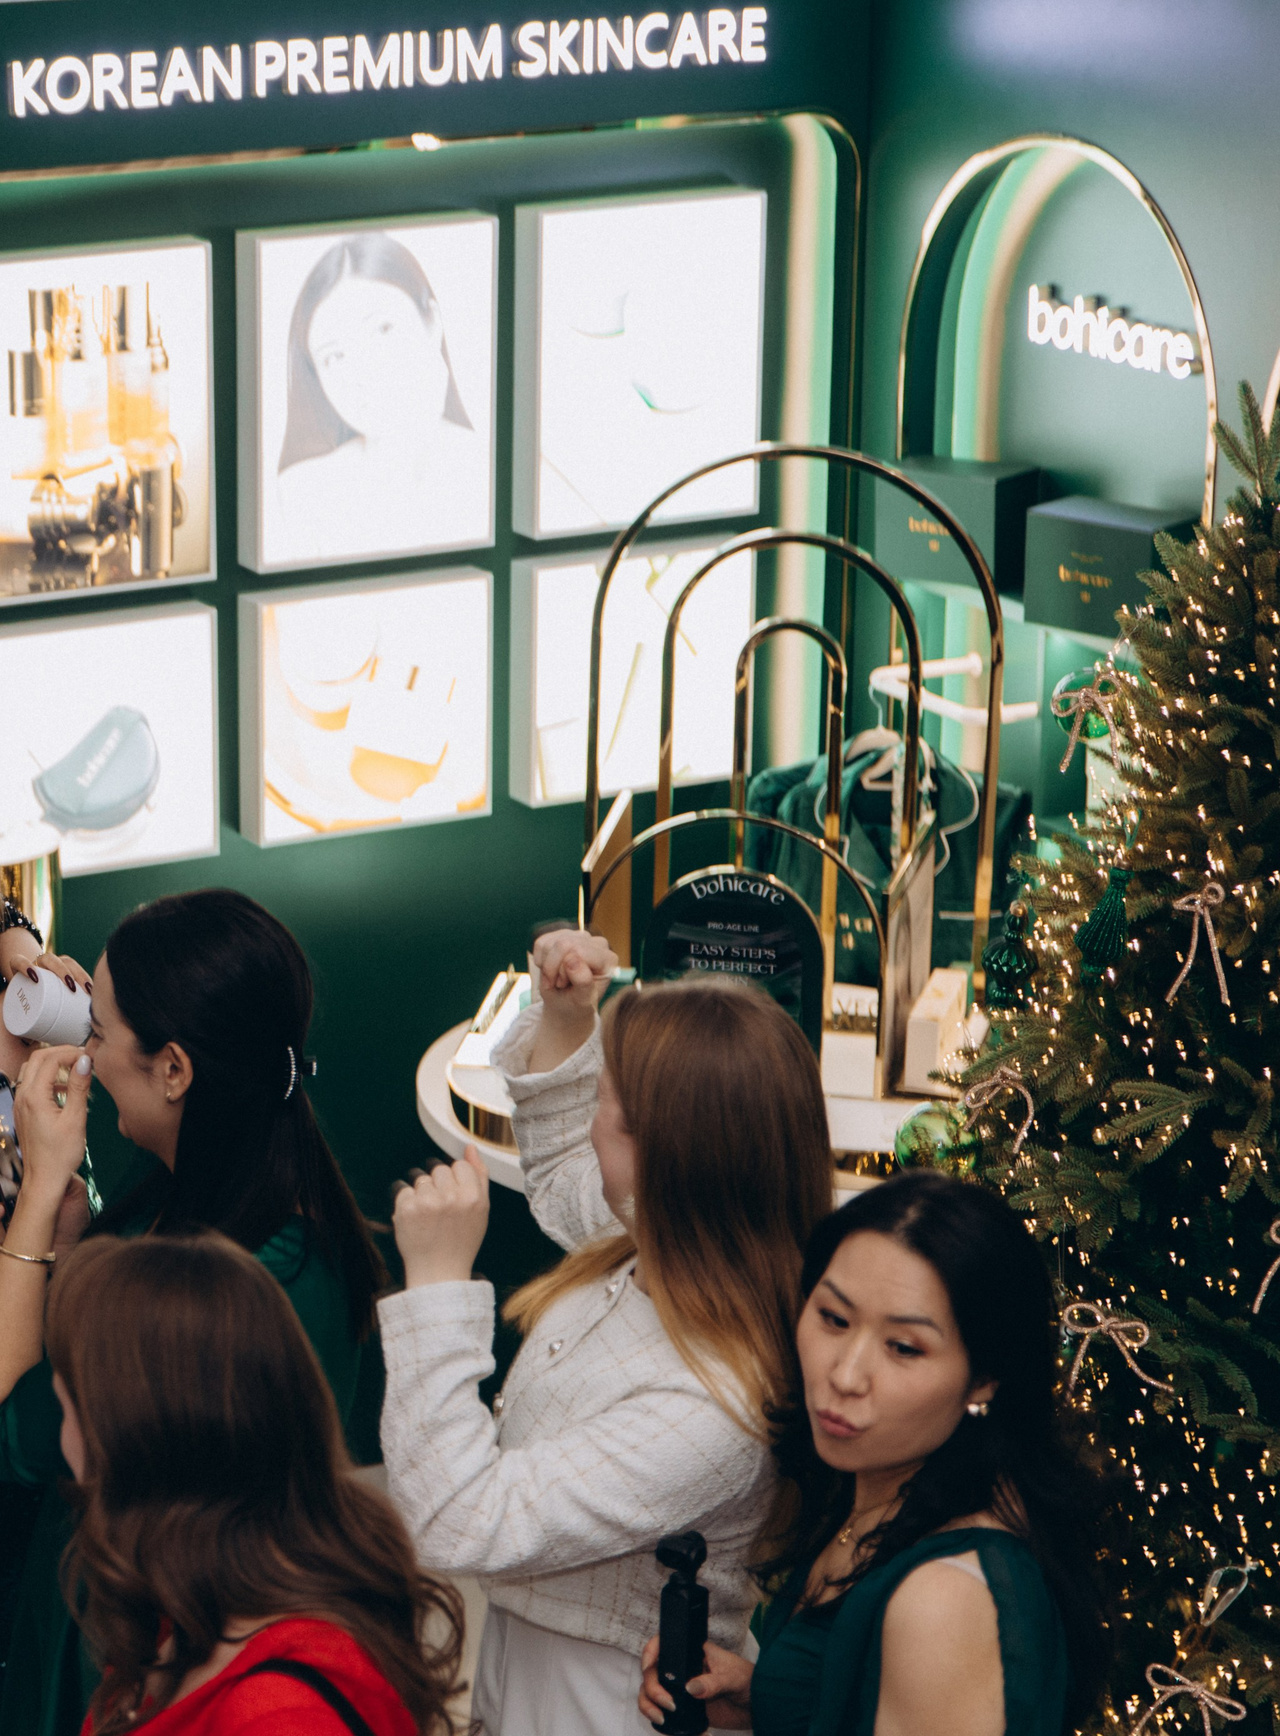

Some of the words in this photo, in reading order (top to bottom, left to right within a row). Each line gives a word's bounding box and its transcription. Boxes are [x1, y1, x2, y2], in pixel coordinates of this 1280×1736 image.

[10, 43, 243, 119] KOREAN
[253, 23, 504, 98] PREMIUM
[516, 7, 769, 79] SKINCARE
[1027, 283, 1195, 380] bohicare
[690, 873, 786, 906] bohicare
[707, 921, 742, 933] PRO-AGE
[743, 924, 760, 934] LINE
[688, 957, 710, 970] TO
[711, 959, 778, 976] PERFECT
[689, 943, 728, 957] EASY
[730, 946, 777, 961] STEPS
[16, 987, 31, 1016] DIOR
